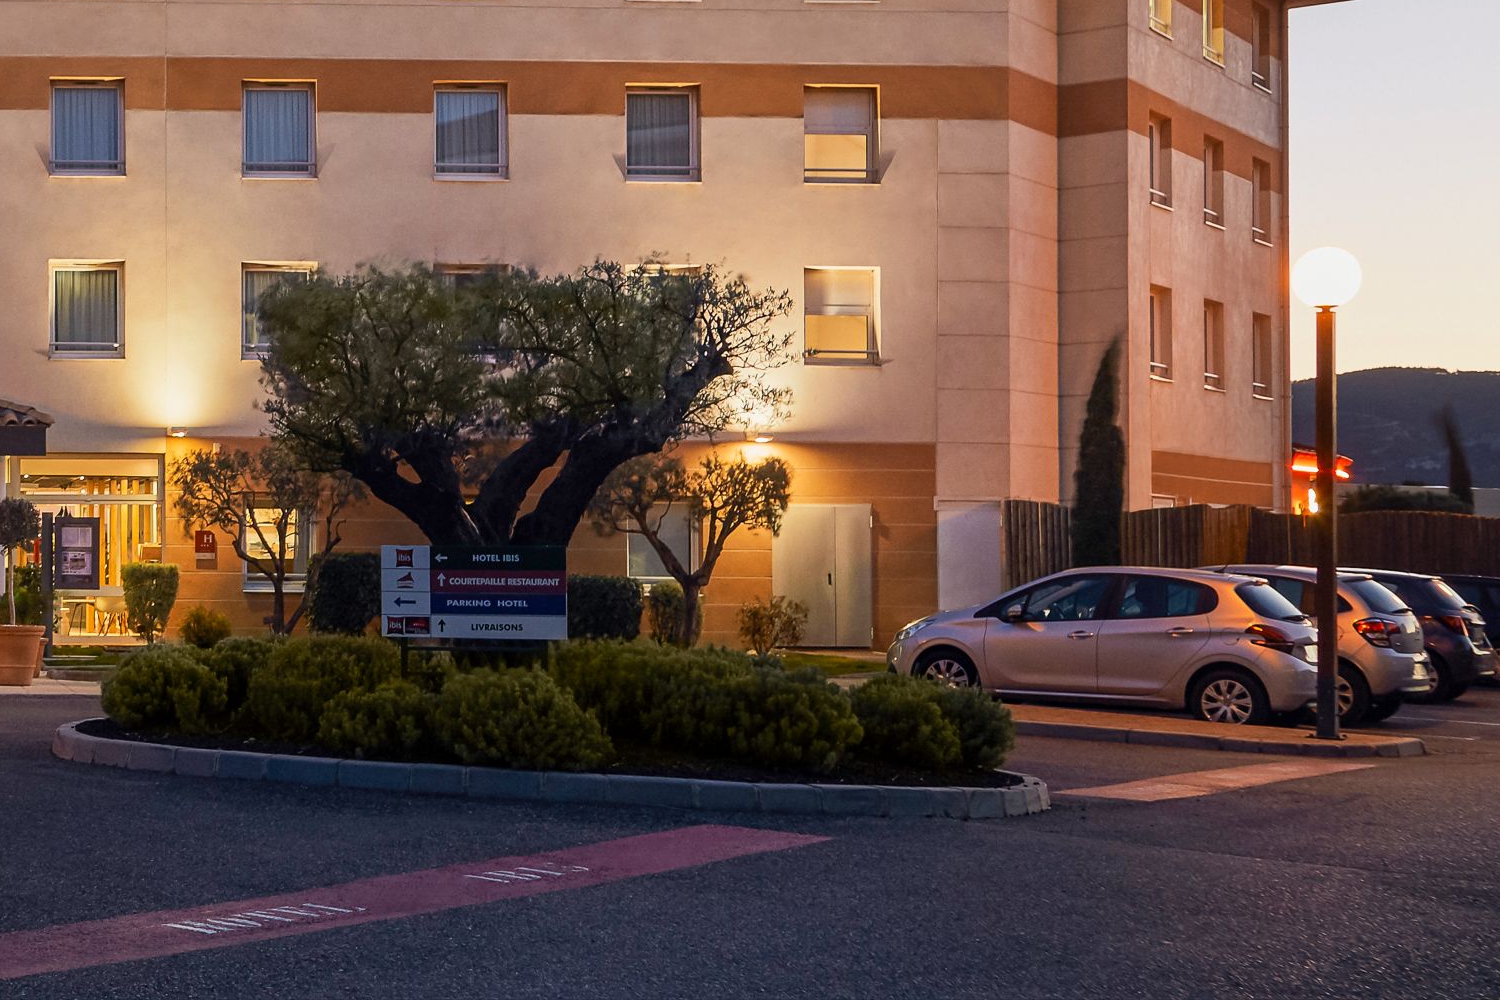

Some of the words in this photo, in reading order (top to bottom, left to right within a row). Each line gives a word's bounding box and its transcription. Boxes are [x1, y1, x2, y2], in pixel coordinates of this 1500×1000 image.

[203, 534, 212, 543] H
[398, 554, 411, 562] ibis
[472, 554, 500, 562] HOTEL
[503, 554, 520, 562] IBIS
[449, 577, 506, 586] COURTEPAILLE
[507, 578, 560, 587] RESTAURANT
[446, 599, 491, 607] PARKING
[497, 600, 529, 608] HOTEL
[471, 623, 524, 632] LIVRAISONS
